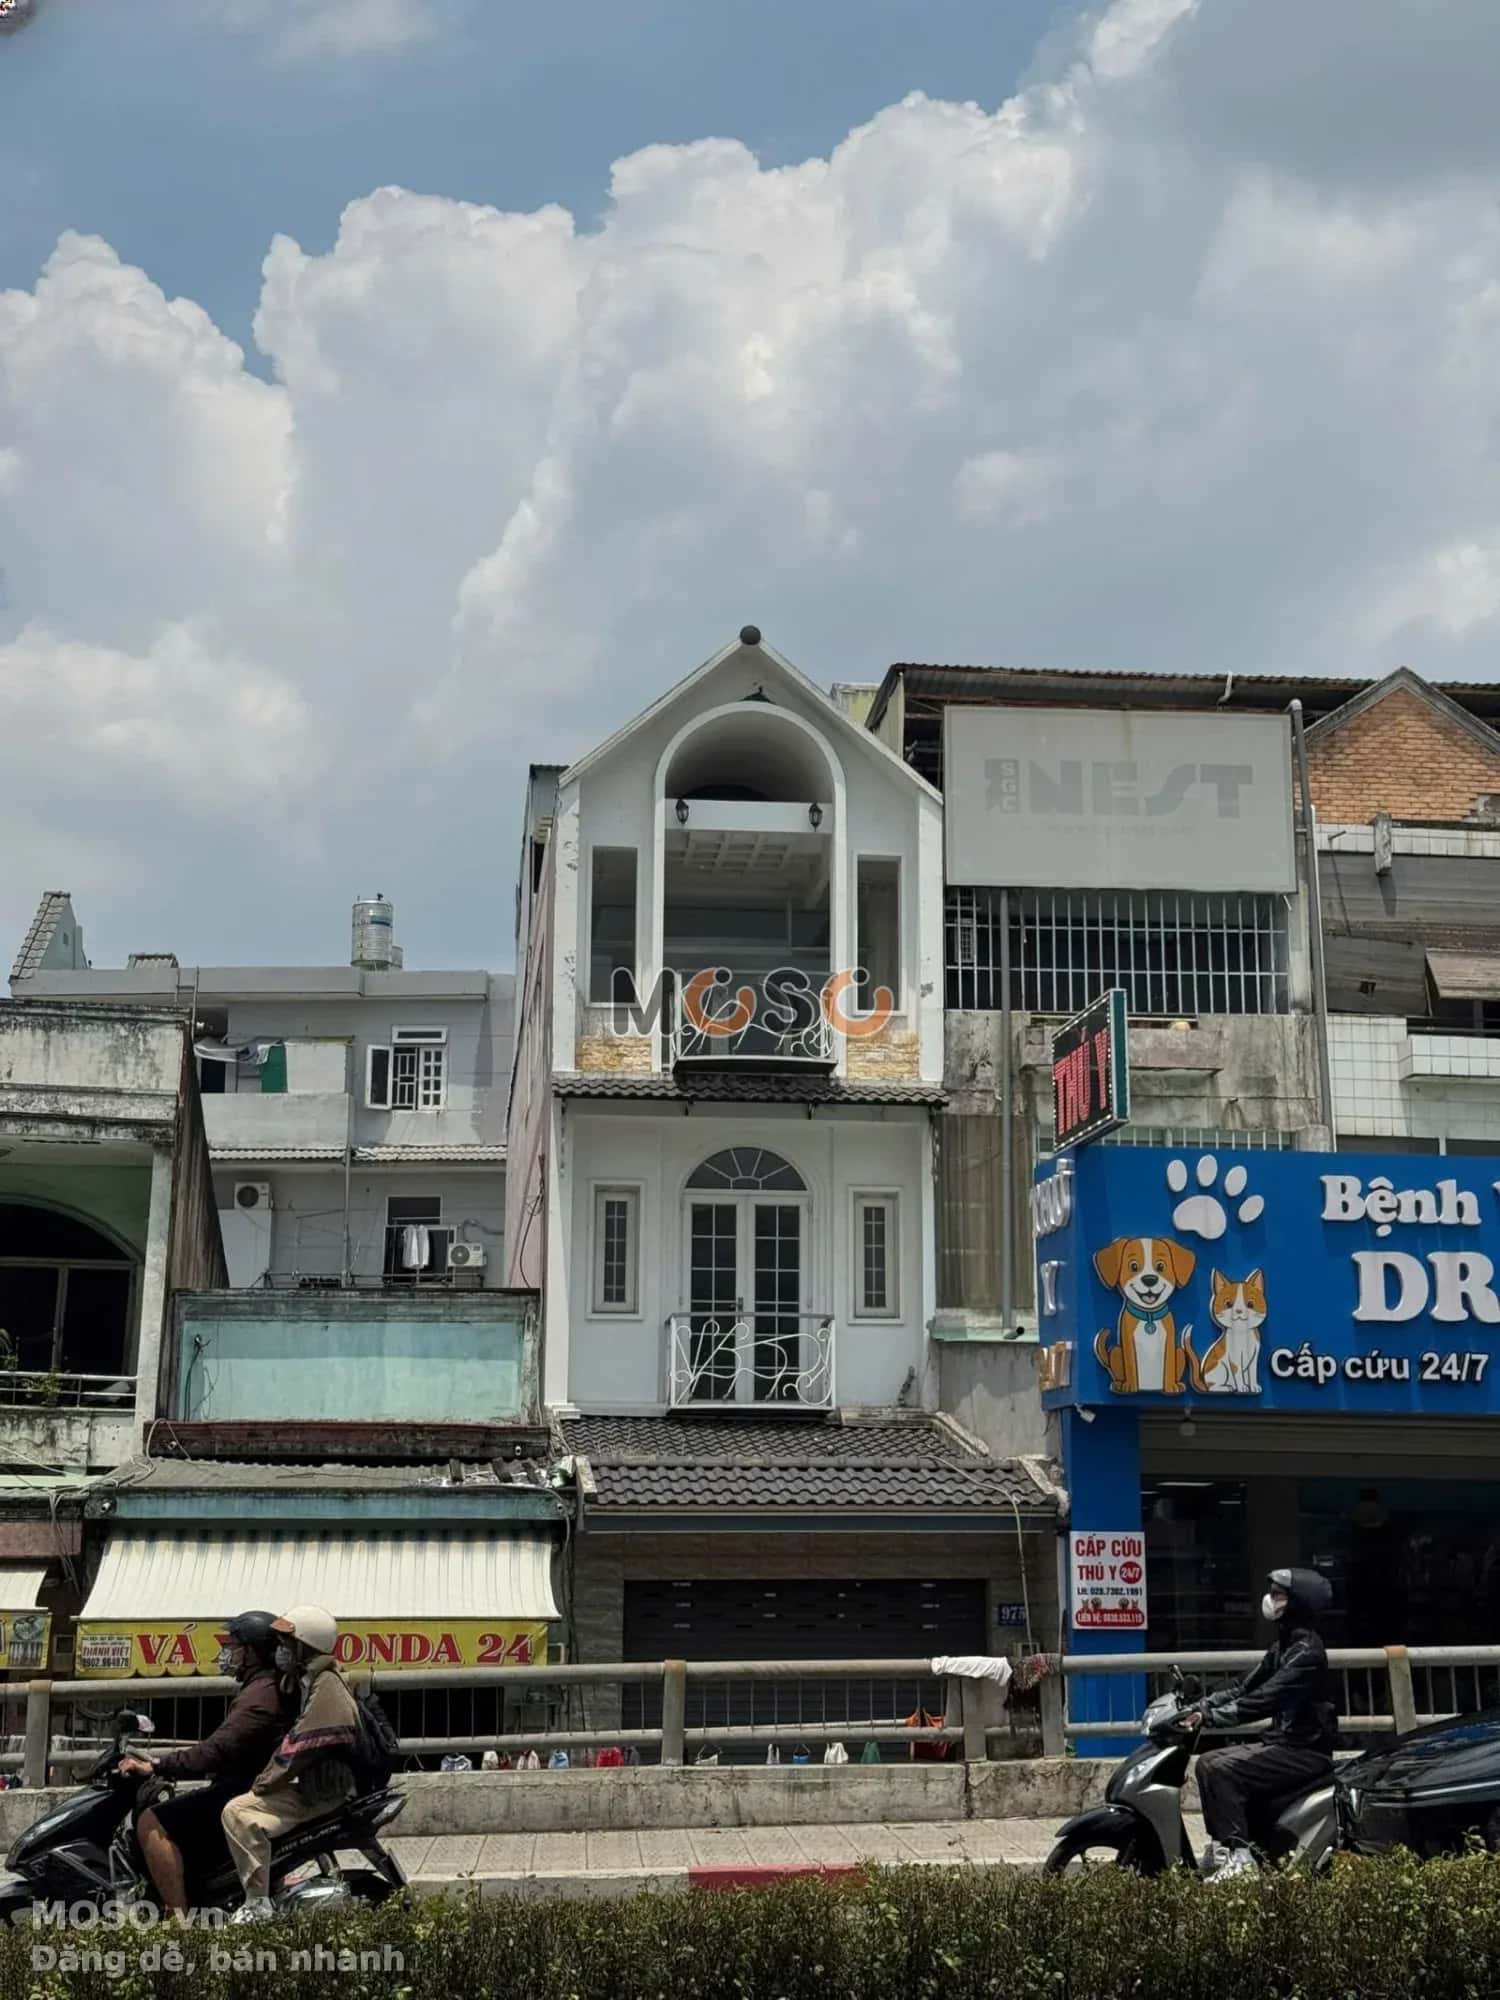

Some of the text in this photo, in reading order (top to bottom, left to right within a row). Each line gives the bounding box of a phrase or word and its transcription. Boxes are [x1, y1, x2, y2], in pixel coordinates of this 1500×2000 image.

[1055, 1026, 1108, 1136] THÚ Y
[1320, 1174, 1482, 1237] Bệnh
[1271, 1342, 1489, 1384] Cấp cứu 24/7
[1075, 1533, 1142, 1557] CẤP CỨU
[1077, 1562, 1141, 1581] THÚ Y 24/7
[136, 1623, 199, 1666] VÁ
[332, 1632, 532, 1664] ONDA 24
